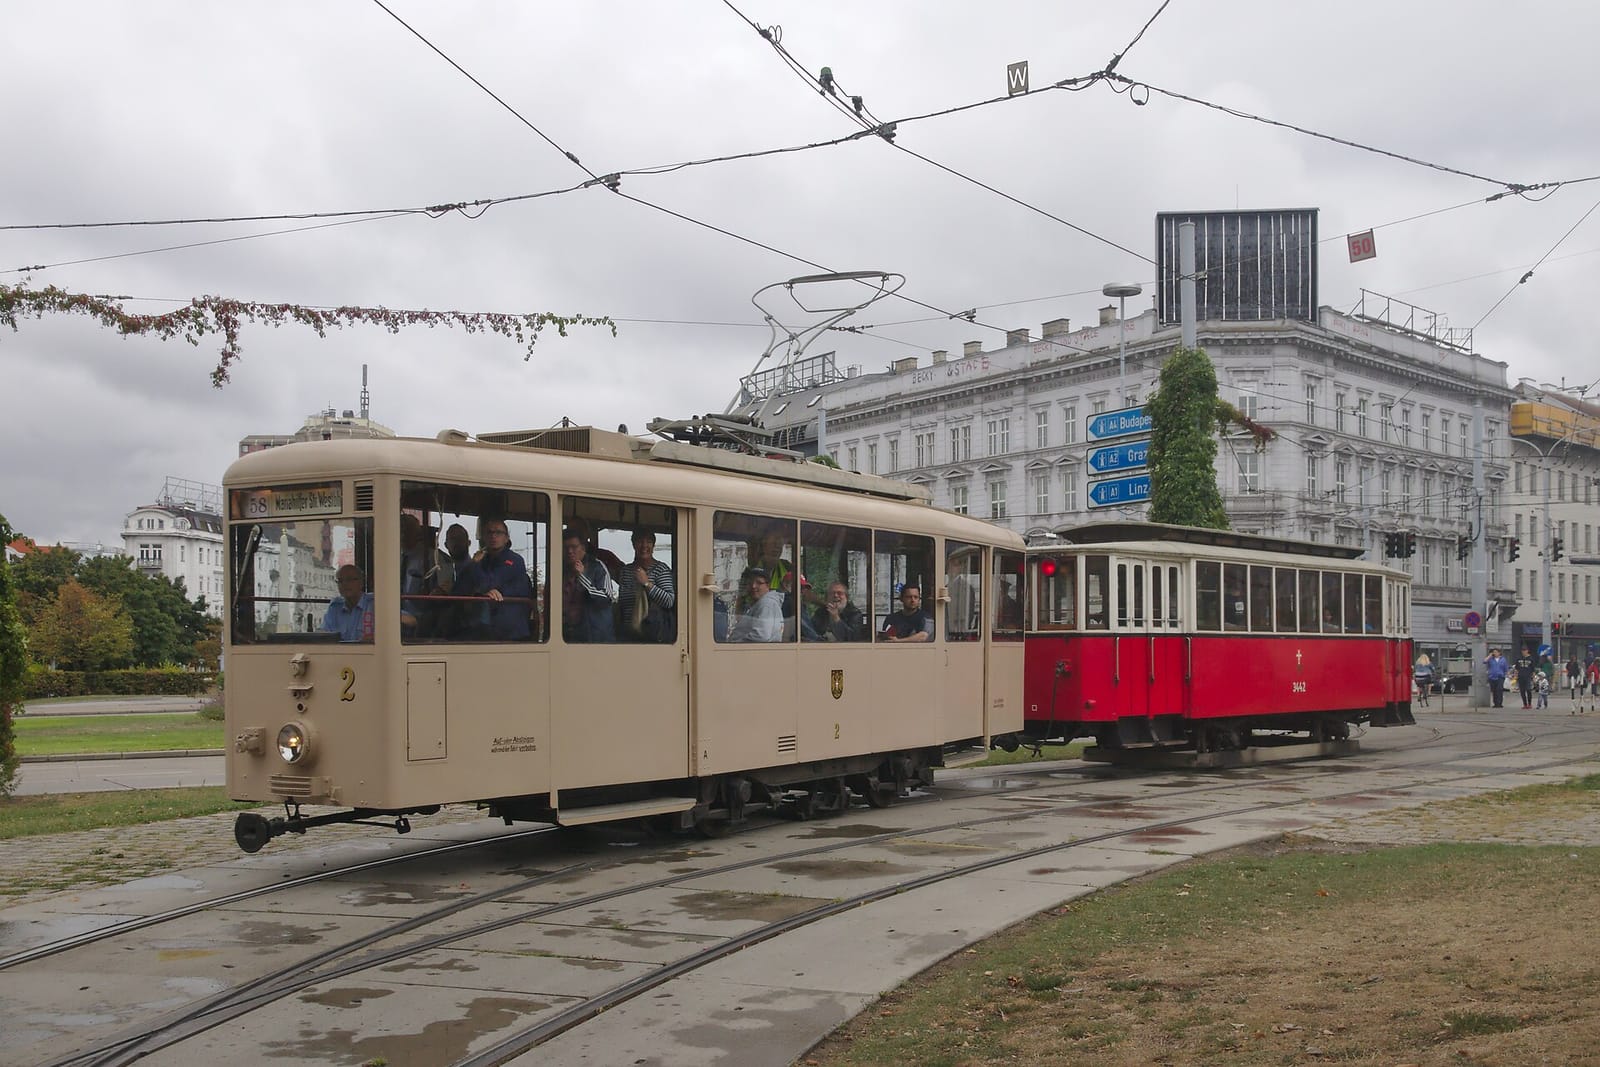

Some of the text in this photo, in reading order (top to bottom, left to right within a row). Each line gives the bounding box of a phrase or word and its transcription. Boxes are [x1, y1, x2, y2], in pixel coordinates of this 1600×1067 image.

[1008, 66, 1027, 89] W
[1351, 238, 1371, 257] 50
[1109, 448, 1148, 463] A2 Graz
[1110, 483, 1149, 498] A1 Linz
[249, 497, 268, 514] 58
[340, 668, 356, 702] 2
[1292, 681, 1306, 693] 3442
[833, 722, 840, 740] 2
